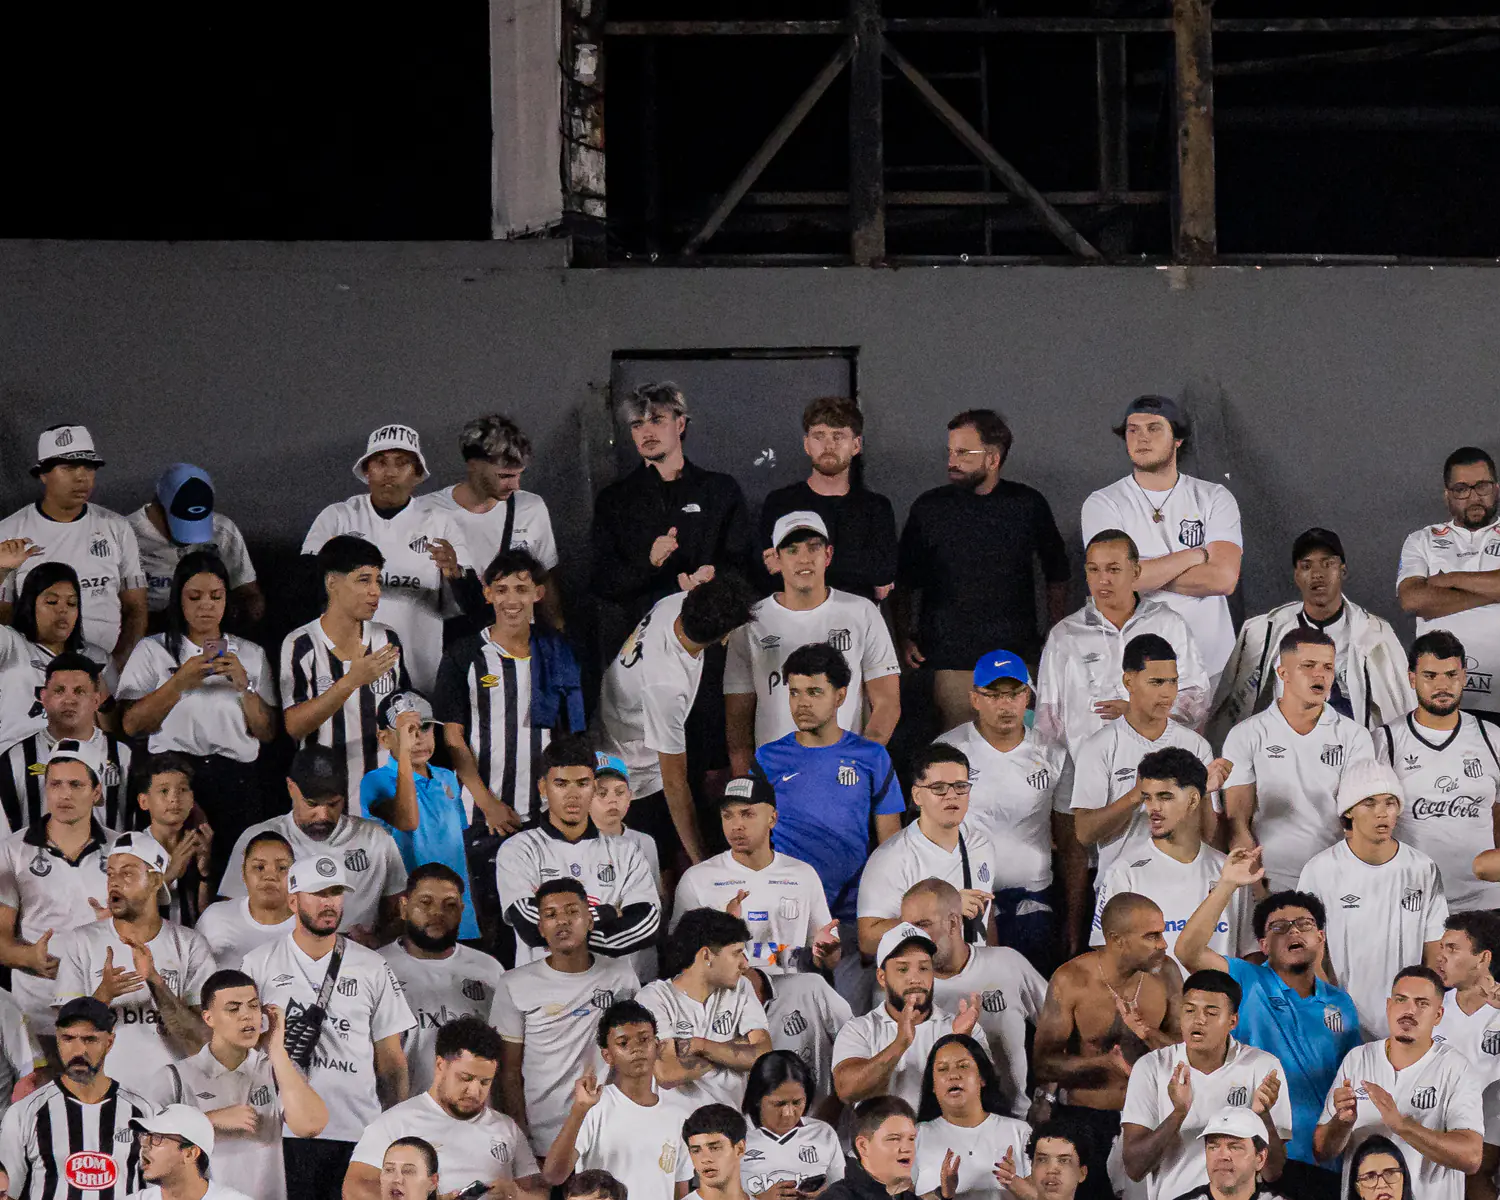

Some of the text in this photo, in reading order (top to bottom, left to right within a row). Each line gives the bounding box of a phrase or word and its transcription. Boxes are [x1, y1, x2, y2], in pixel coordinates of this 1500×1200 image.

[1412, 796, 1485, 820] Coca-Cola
[72, 1156, 105, 1171] BOM
[75, 1169, 112, 1186] BRIL
